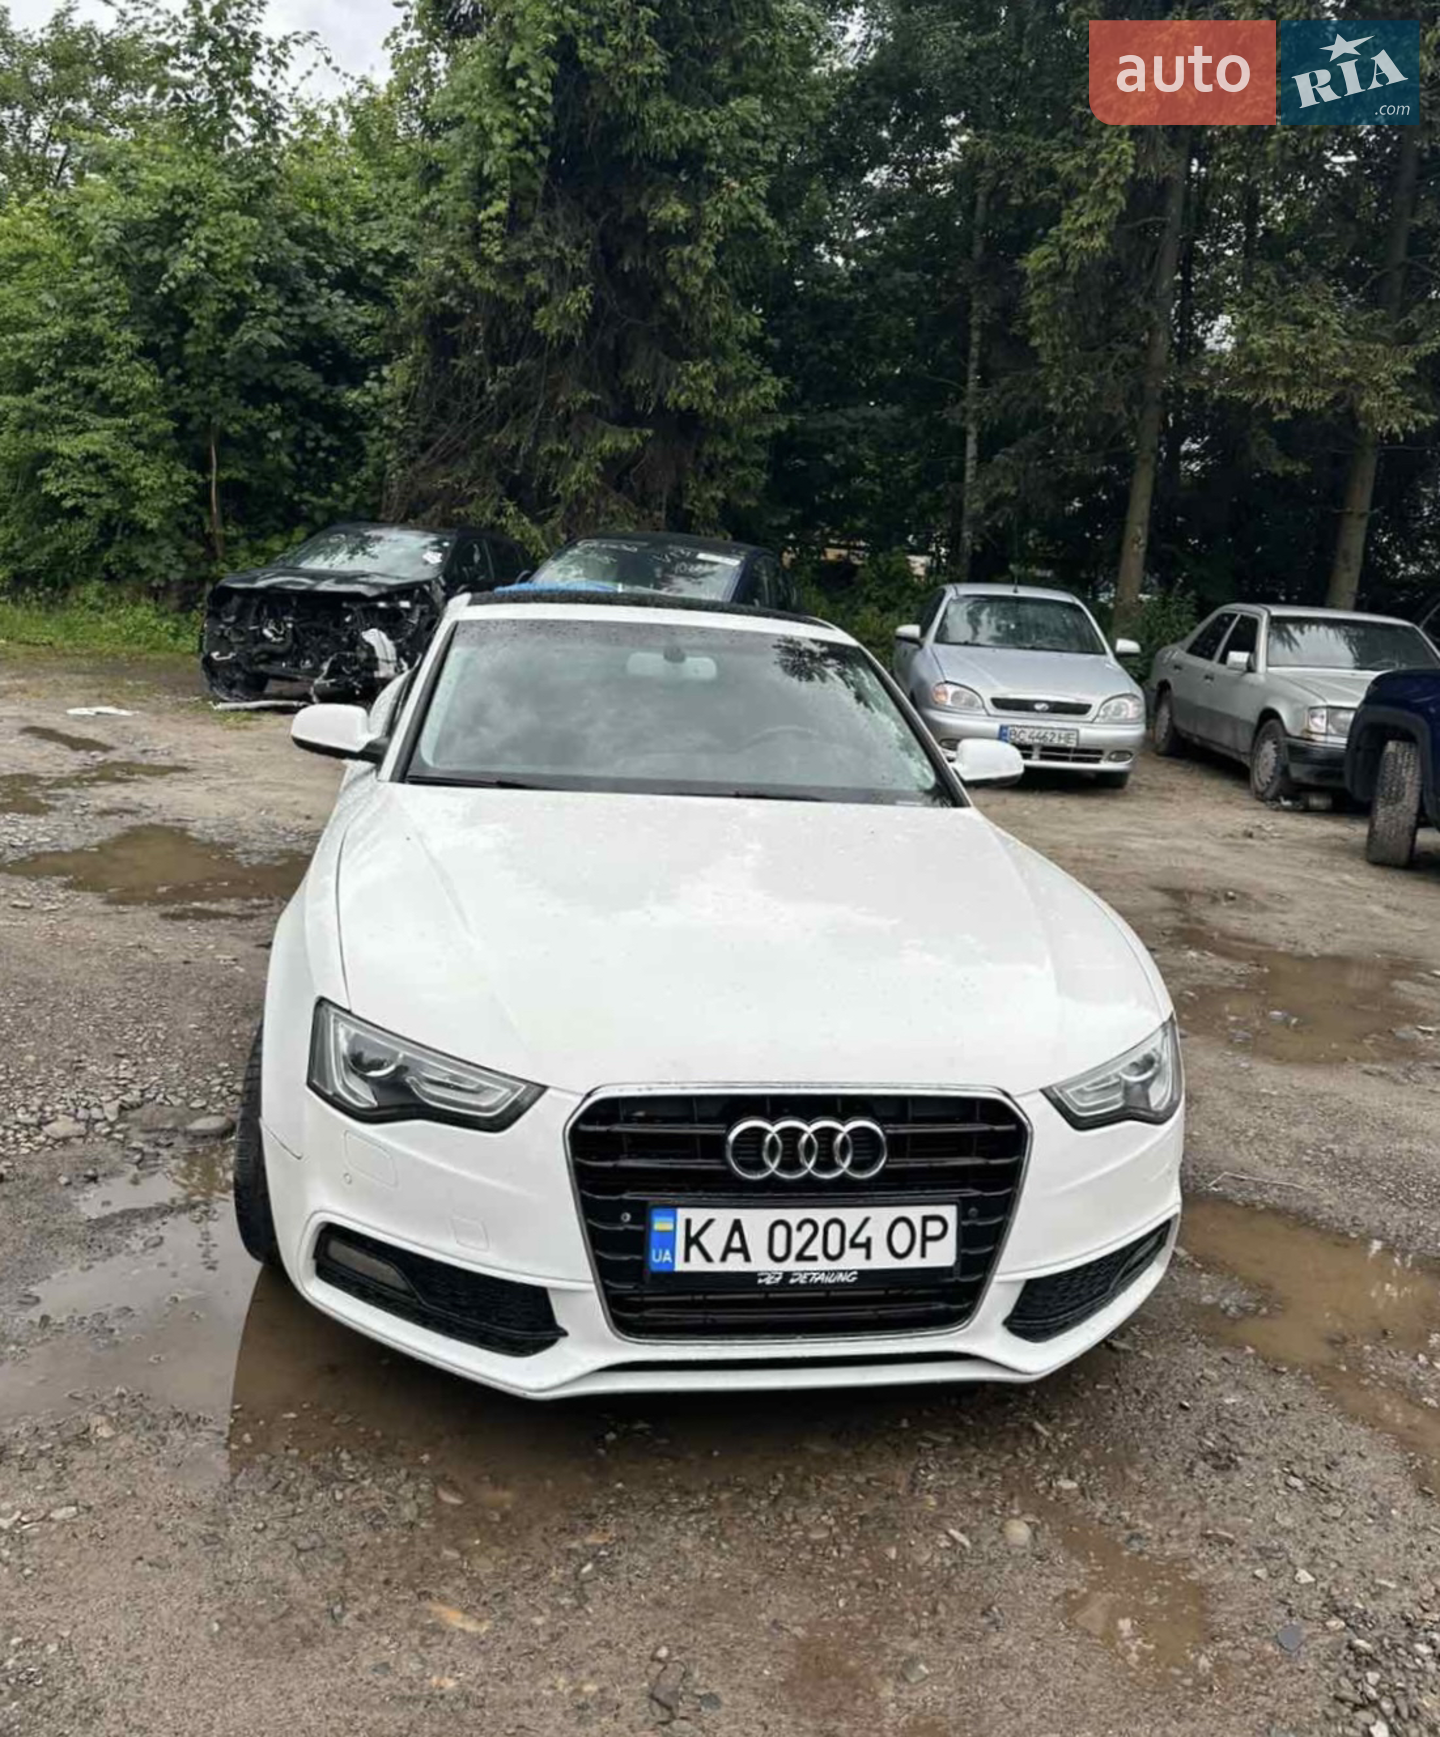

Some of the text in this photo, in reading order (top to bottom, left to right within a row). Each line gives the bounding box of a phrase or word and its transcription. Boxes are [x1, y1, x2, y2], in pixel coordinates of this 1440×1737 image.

[1009, 729, 1026, 742] BC
[683, 1214, 949, 1263] KA 0204 OP
[652, 1249, 672, 1263] UA
